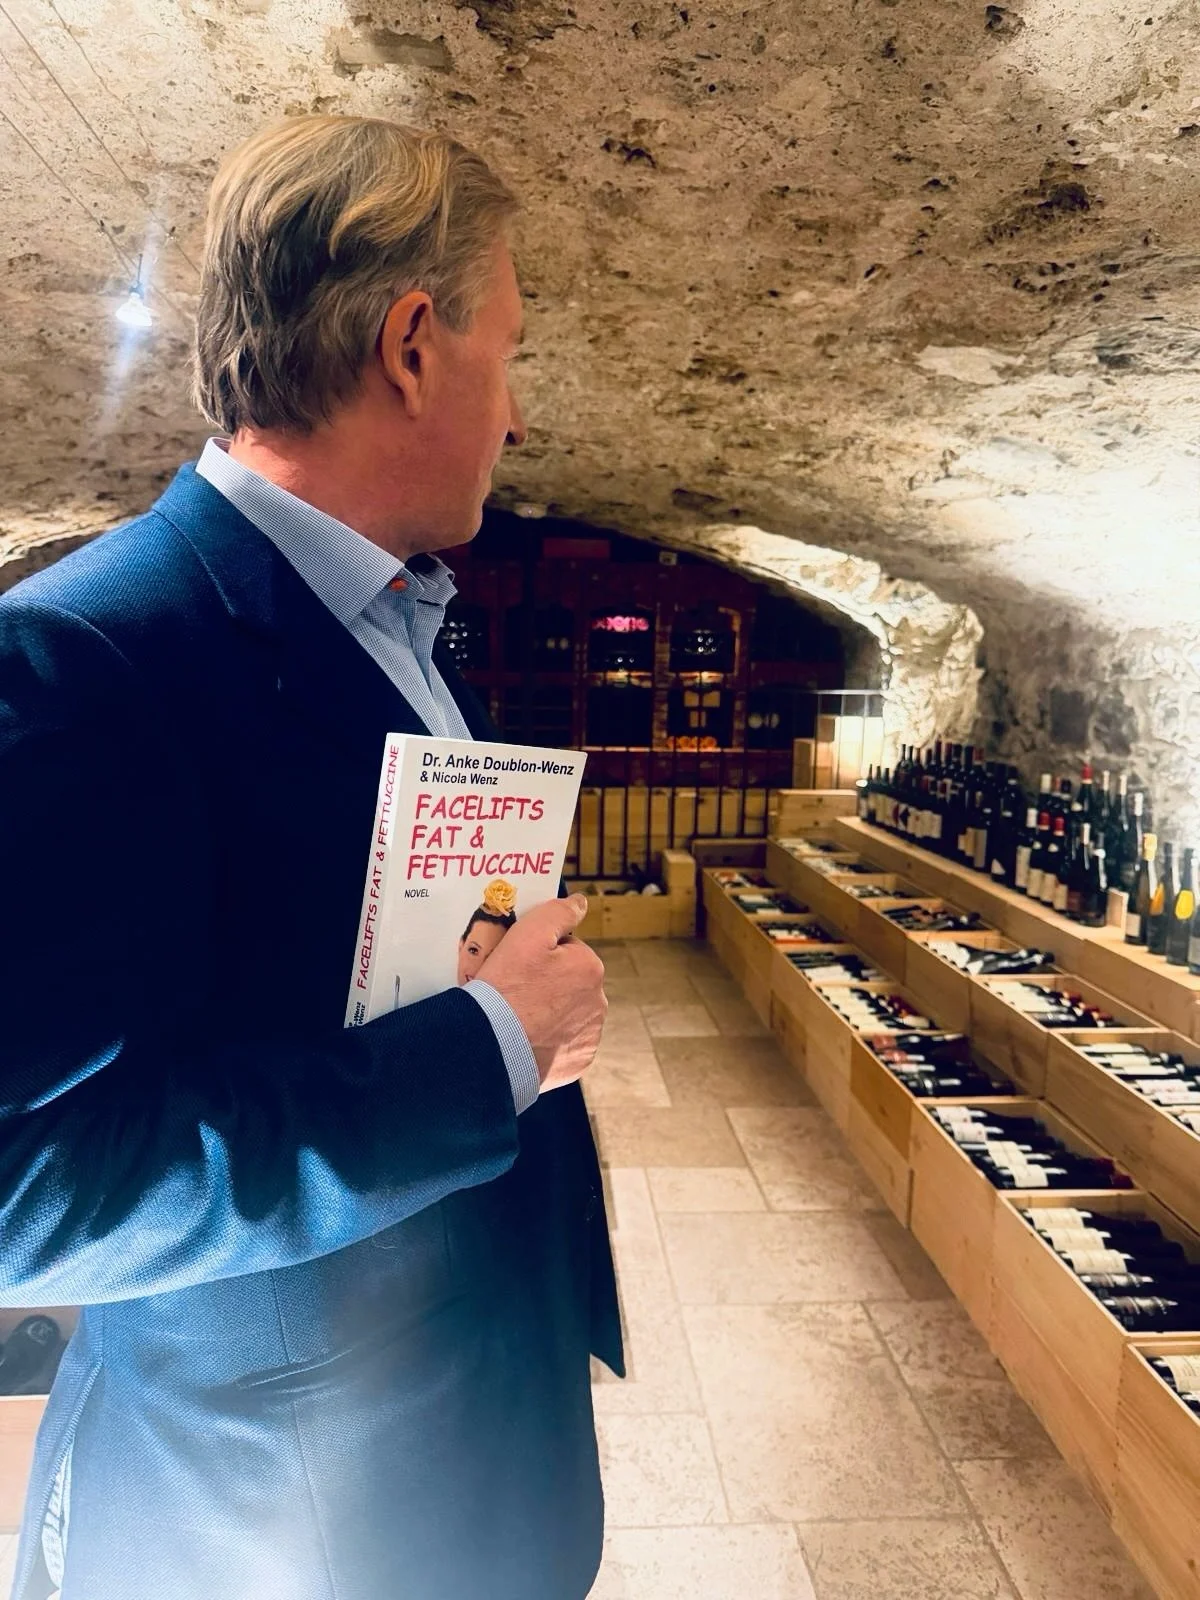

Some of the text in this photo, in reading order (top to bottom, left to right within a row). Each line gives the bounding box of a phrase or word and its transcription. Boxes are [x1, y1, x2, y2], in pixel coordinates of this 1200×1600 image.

[422, 752, 575, 776] Dr. Anke Doublon-Wenz
[420, 771, 499, 785] & Nicola Wenz
[415, 793, 545, 821] FACELIFTS
[410, 825, 485, 850] FAT &
[357, 744, 400, 990] FACELIFTS FAT & FETTUCCINE
[406, 851, 555, 881] FETTUCCINE
[404, 888, 430, 899] NOVEL
